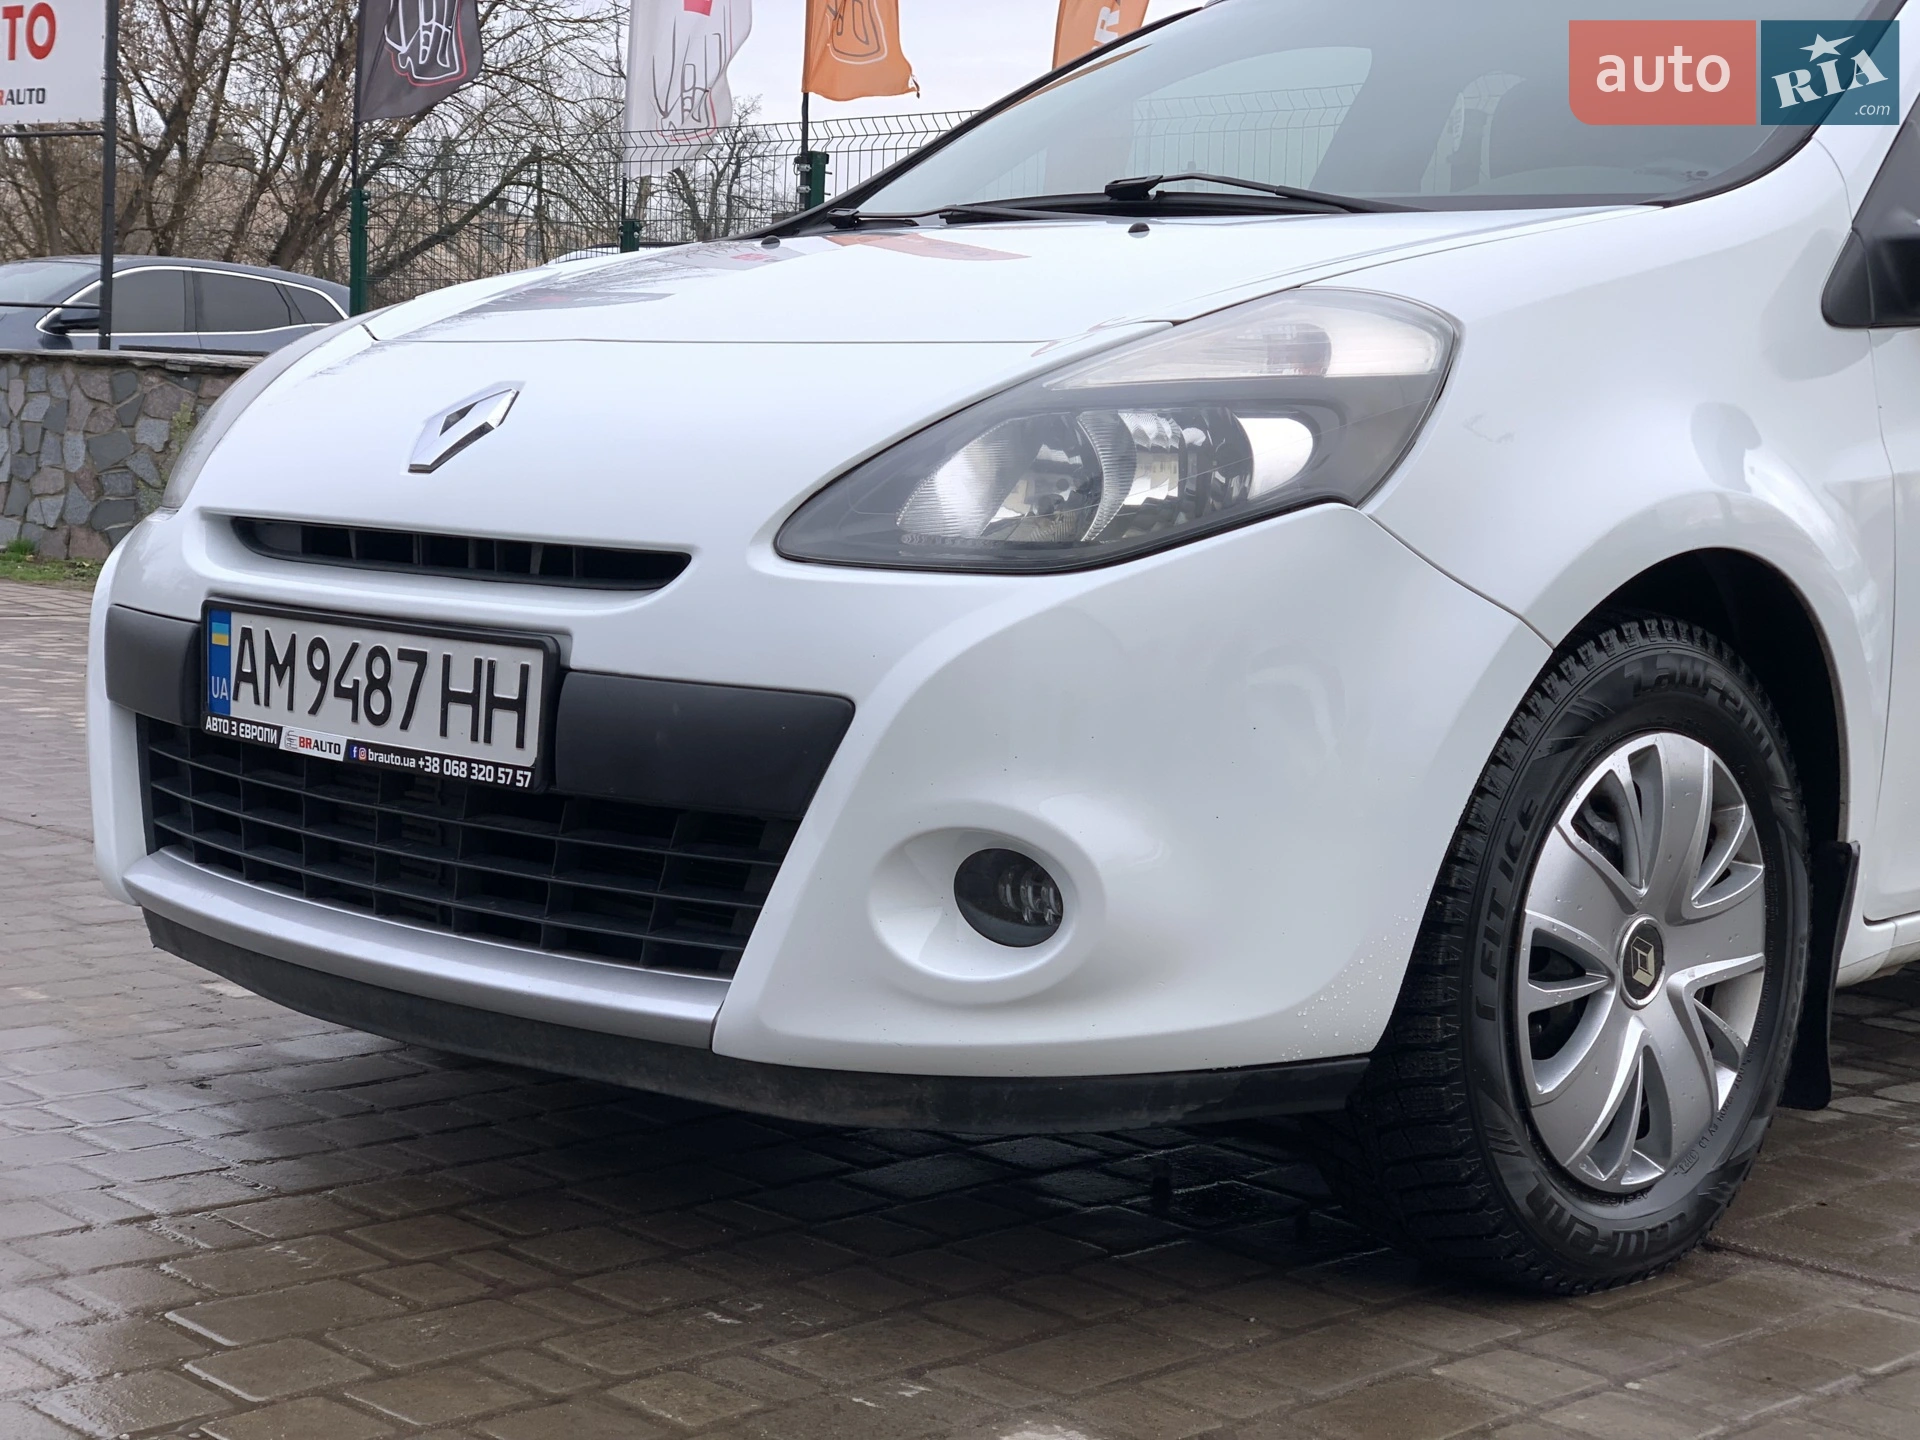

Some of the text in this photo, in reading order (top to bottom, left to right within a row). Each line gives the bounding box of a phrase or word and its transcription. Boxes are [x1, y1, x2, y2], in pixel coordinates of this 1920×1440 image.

[211, 675, 230, 701] UA
[306, 636, 428, 731] 9487
[205, 715, 229, 735] АВТО
[238, 724, 278, 745] ЄВРОПИ
[298, 736, 342, 756] BRAUTO
[368, 748, 532, 788] brauto.ua +38 068 320 57 57
